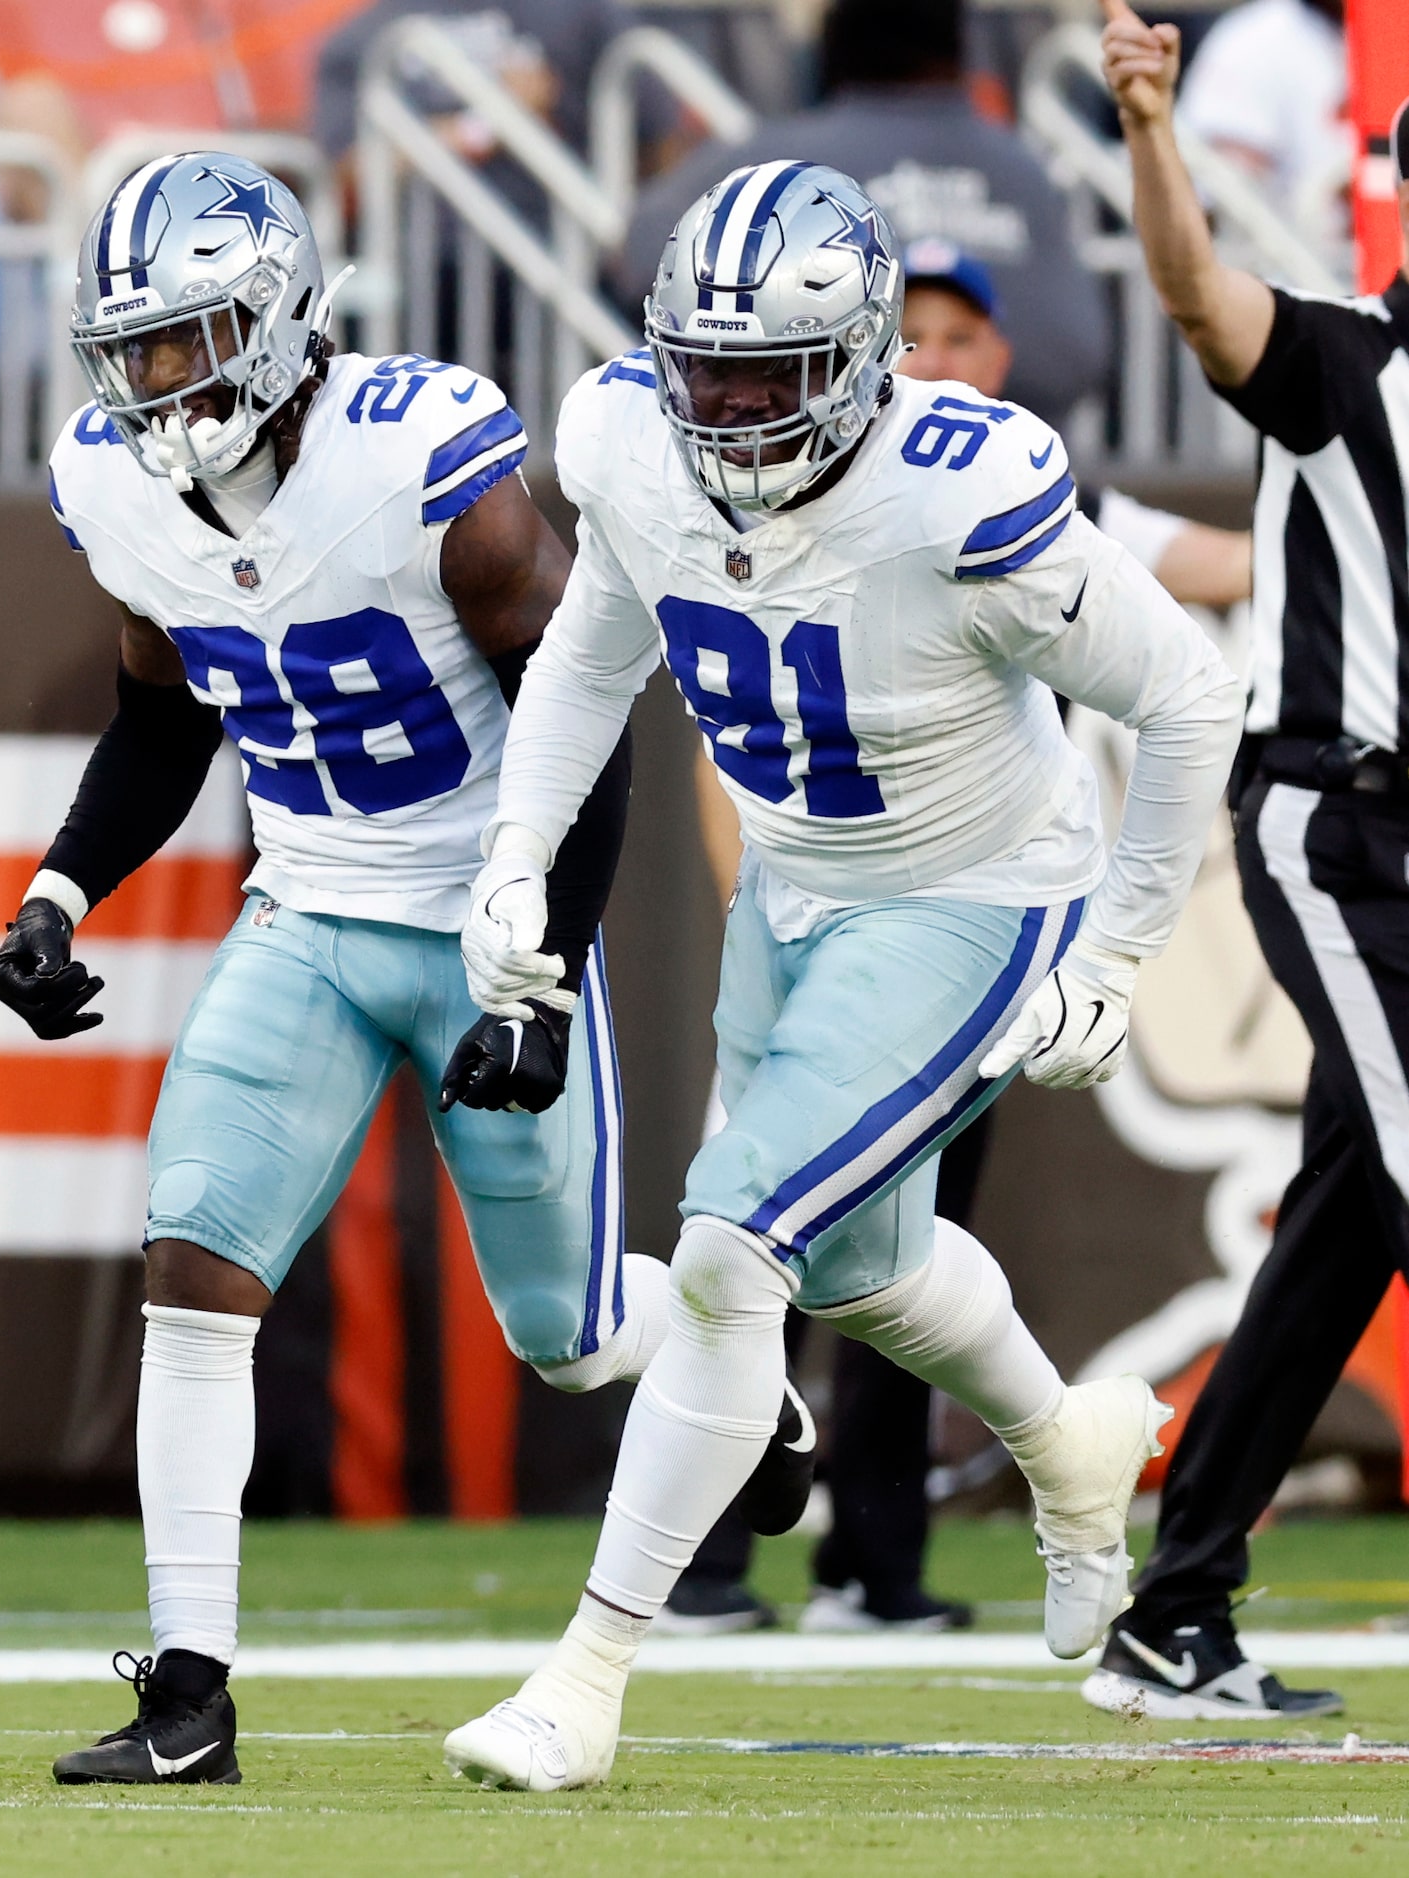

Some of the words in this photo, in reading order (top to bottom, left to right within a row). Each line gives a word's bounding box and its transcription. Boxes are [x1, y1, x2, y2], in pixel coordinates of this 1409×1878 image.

[103, 297, 148, 316] COWBOYS
[697, 318, 748, 332] COWBOYS
[783, 326, 821, 336] OAKLEY
[346, 352, 457, 424] 28
[901, 396, 1016, 471] 91
[729, 561, 749, 578] NFL
[237, 571, 258, 588] NFL
[166, 606, 473, 817] 28
[655, 594, 887, 818] 91
